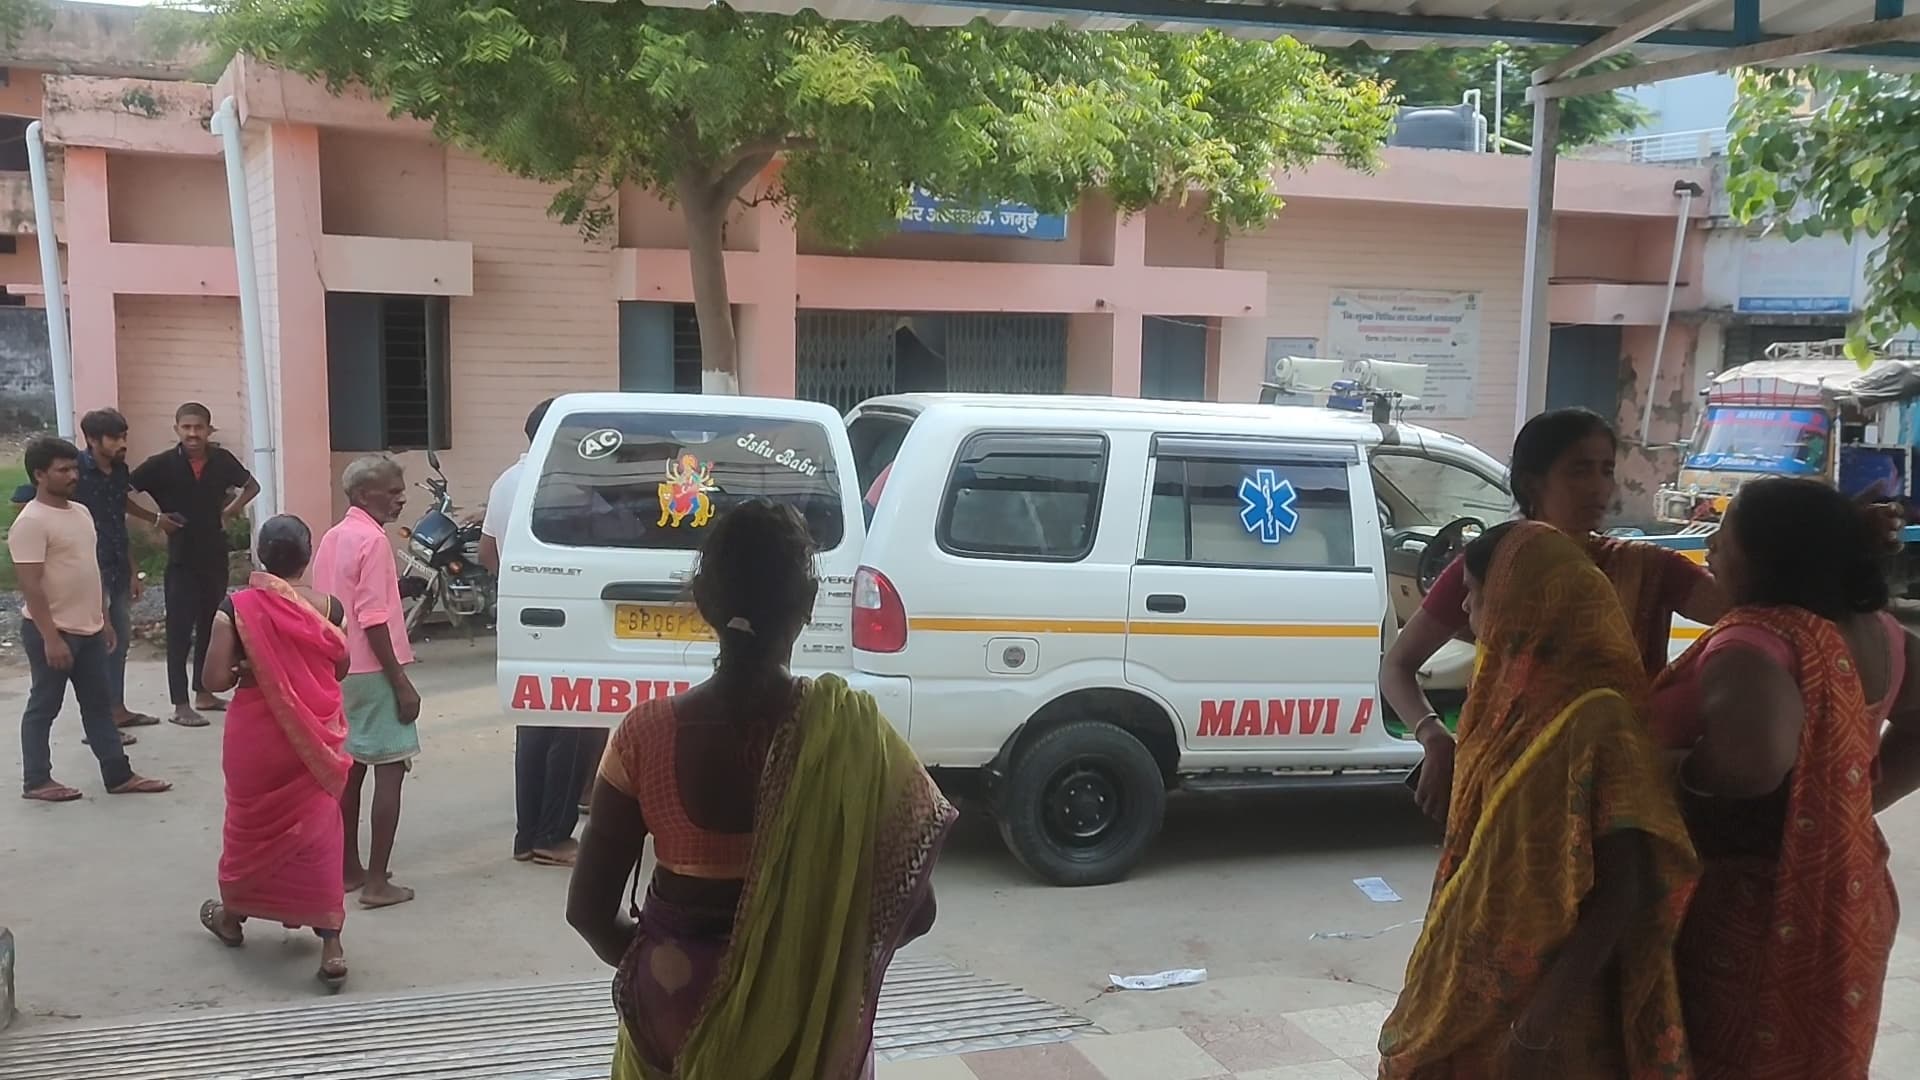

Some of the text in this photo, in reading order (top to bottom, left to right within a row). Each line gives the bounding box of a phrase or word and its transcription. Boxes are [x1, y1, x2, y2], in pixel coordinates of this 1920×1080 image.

[585, 431, 617, 455] AC
[775, 449, 818, 477] Babu
[511, 565, 583, 576] CHEVROLET
[1197, 699, 1340, 737] MANVI
